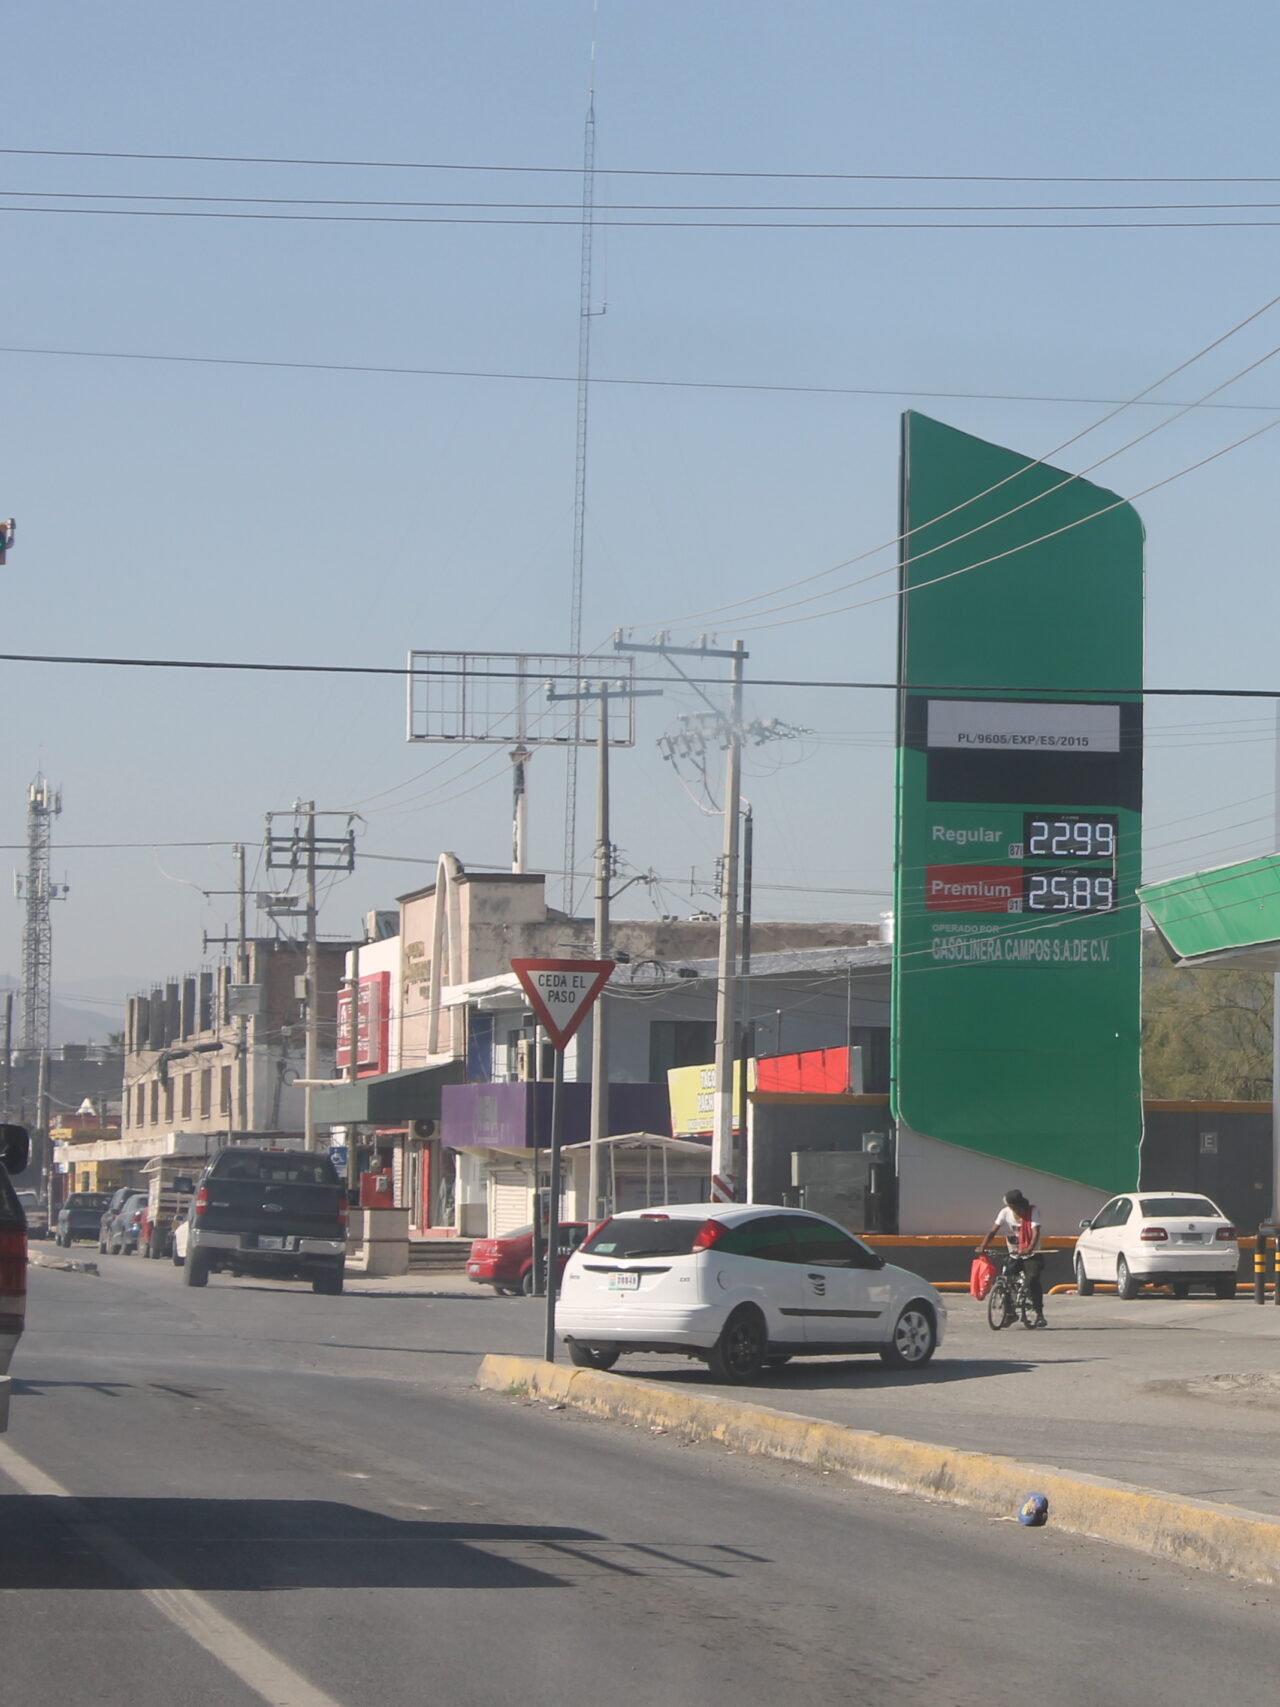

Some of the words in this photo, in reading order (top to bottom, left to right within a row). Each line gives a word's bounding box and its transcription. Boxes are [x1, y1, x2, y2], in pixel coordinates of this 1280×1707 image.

[932, 825, 1002, 845] Regular
[931, 880, 1011, 897] Premium
[932, 924, 978, 933] OPERADO
[979, 924, 1000, 933] POR
[932, 937, 1002, 960] GASOLINERA
[1004, 938, 1051, 961] CAMPOS
[538, 974, 567, 988] CEDA
[572, 975, 587, 989] EL
[547, 990, 576, 1004] PASO
